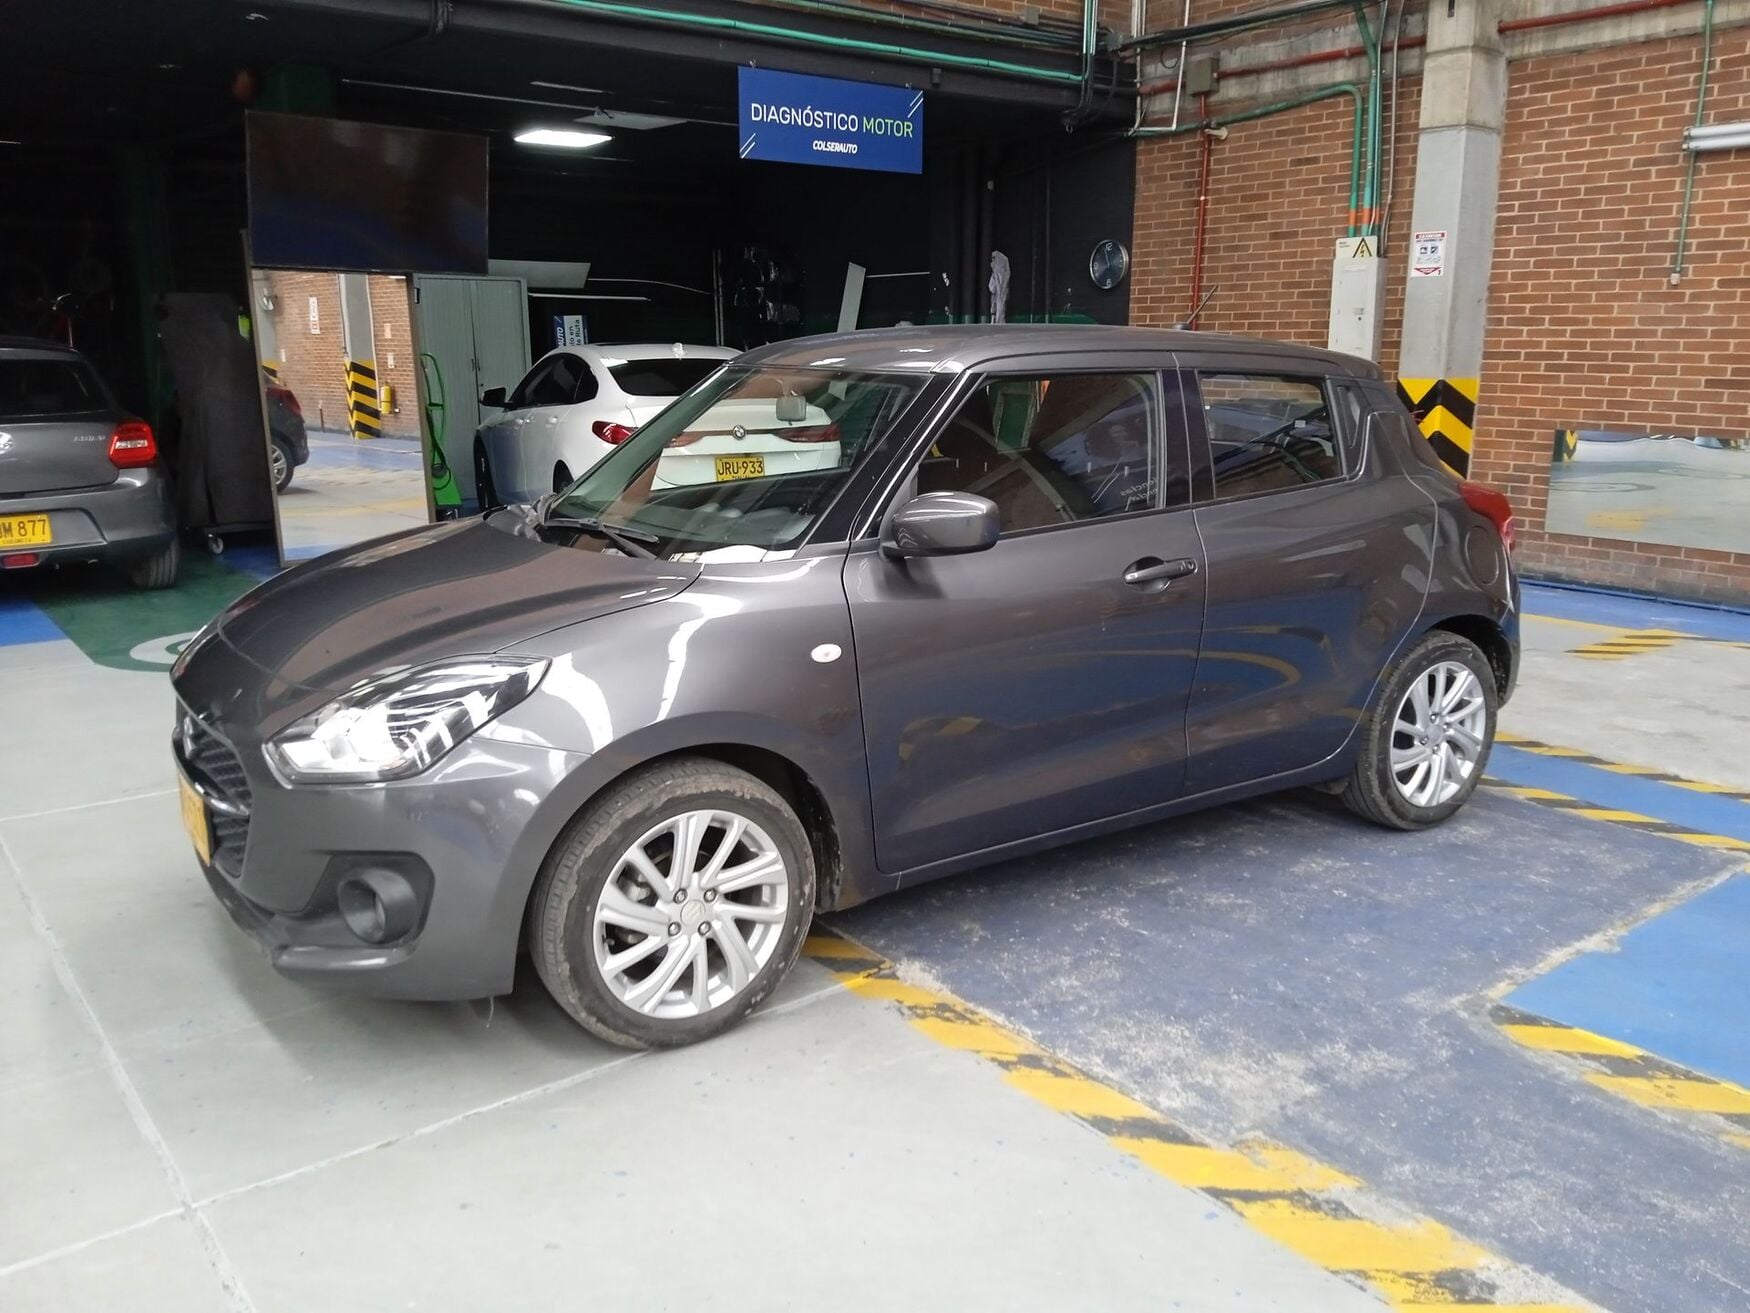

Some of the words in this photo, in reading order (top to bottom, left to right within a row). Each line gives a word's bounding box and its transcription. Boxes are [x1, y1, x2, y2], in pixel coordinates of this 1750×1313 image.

[751, 103, 859, 132] DIAGNÓSTICO
[863, 117, 913, 138] MOTOR
[813, 140, 858, 154] COLSERAUTO
[18, 519, 47, 537] 877
